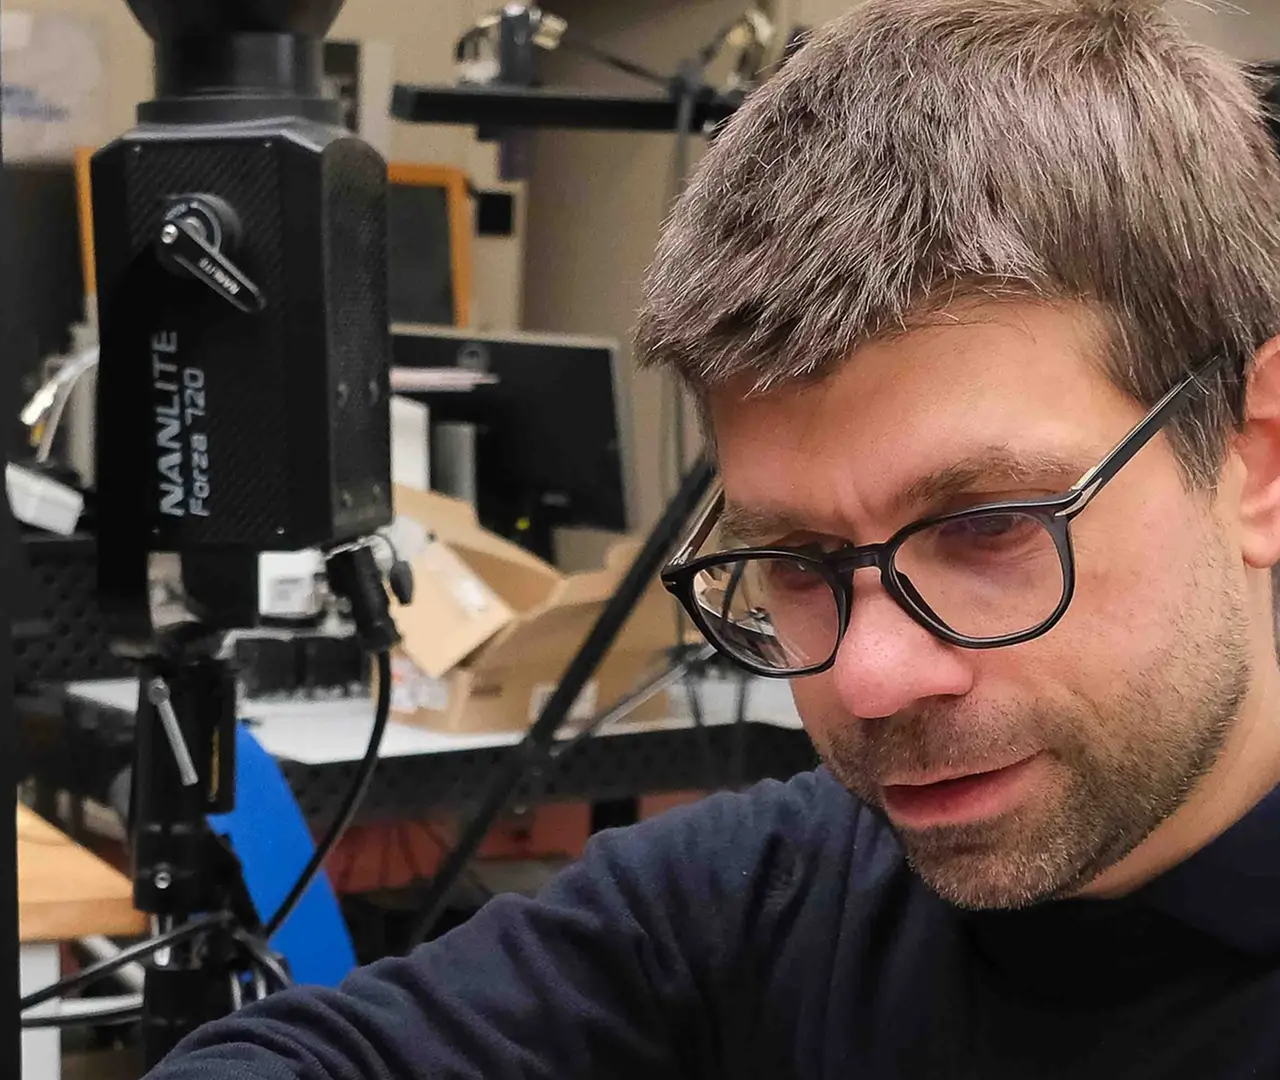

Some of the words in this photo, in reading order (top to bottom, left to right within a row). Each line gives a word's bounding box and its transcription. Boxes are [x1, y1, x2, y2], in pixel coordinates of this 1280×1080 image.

[152, 328, 185, 516] NANLITE
[183, 367, 206, 426] 720
[189, 433, 210, 516] Forza
